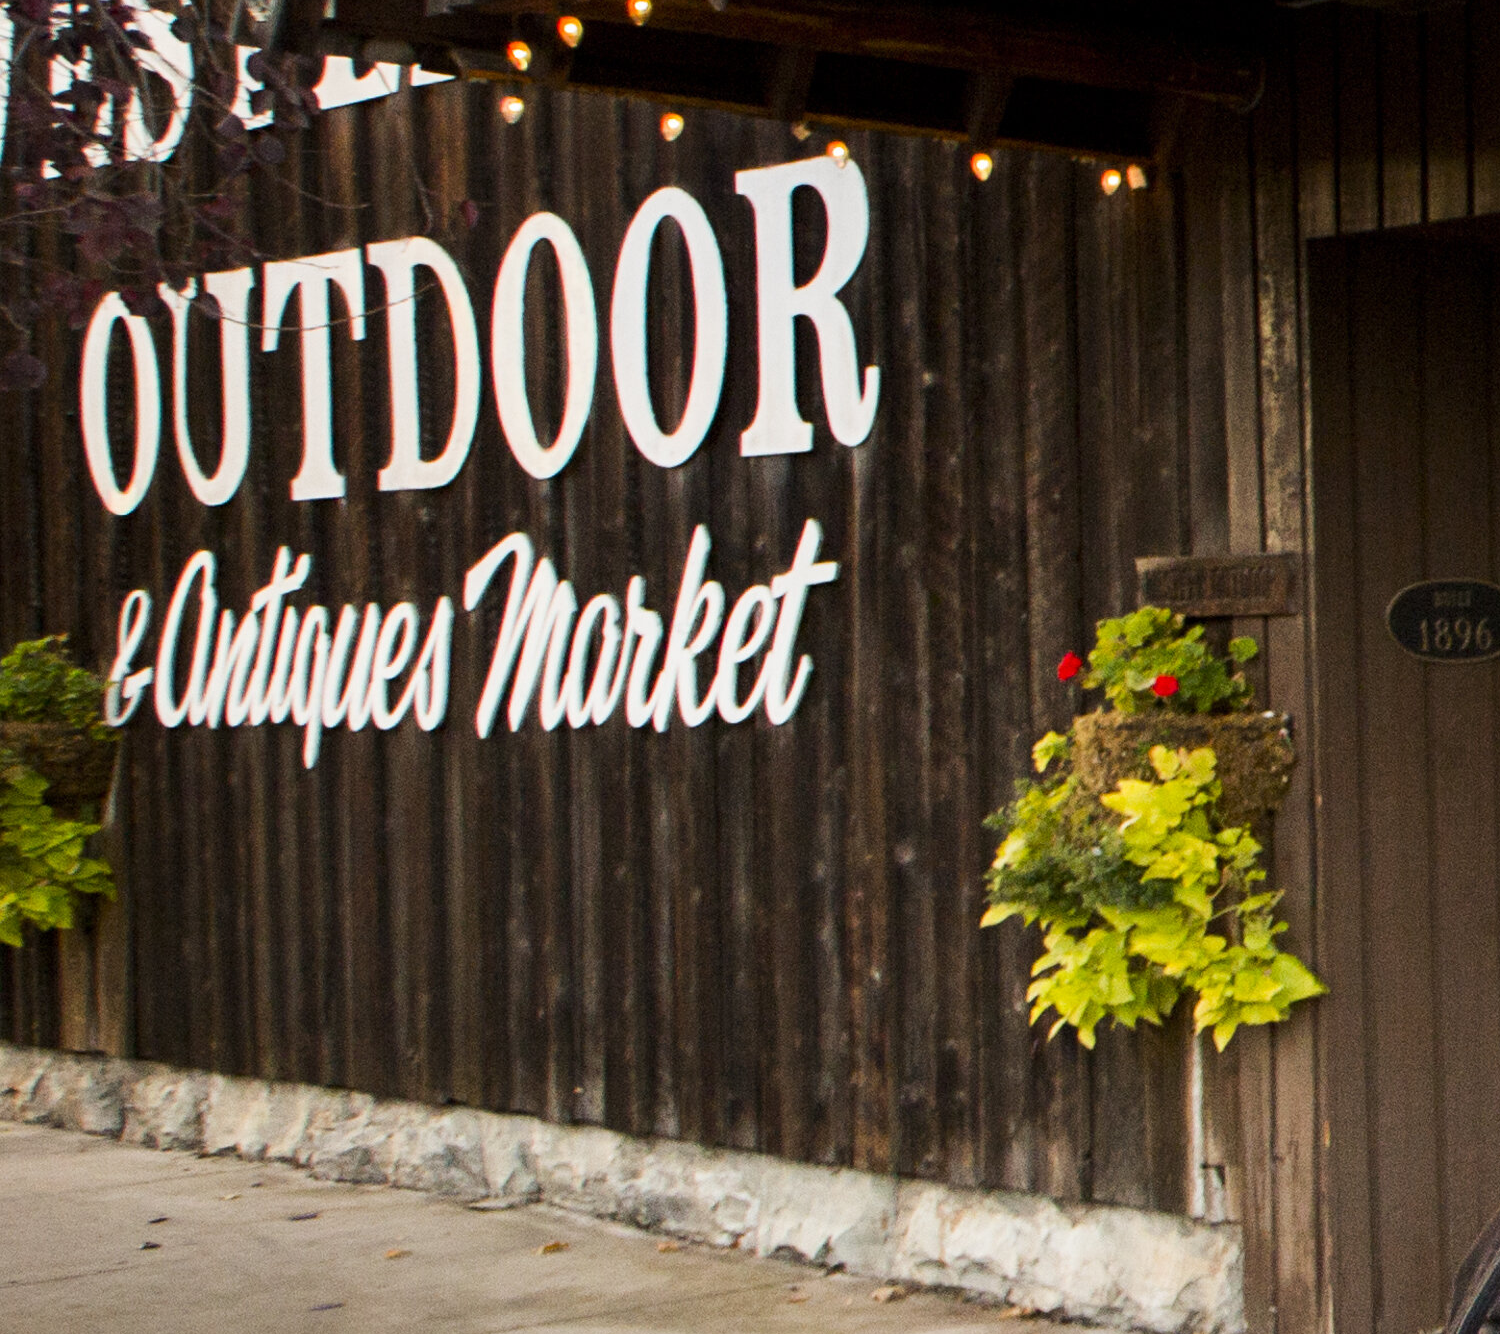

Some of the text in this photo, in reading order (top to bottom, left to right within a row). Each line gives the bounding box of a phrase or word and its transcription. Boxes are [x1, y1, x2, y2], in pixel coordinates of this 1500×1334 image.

[80, 153, 881, 516] OUTDOOR
[154, 548, 453, 769] Antiques
[464, 518, 838, 739] Market
[1419, 617, 1493, 652] 1896
